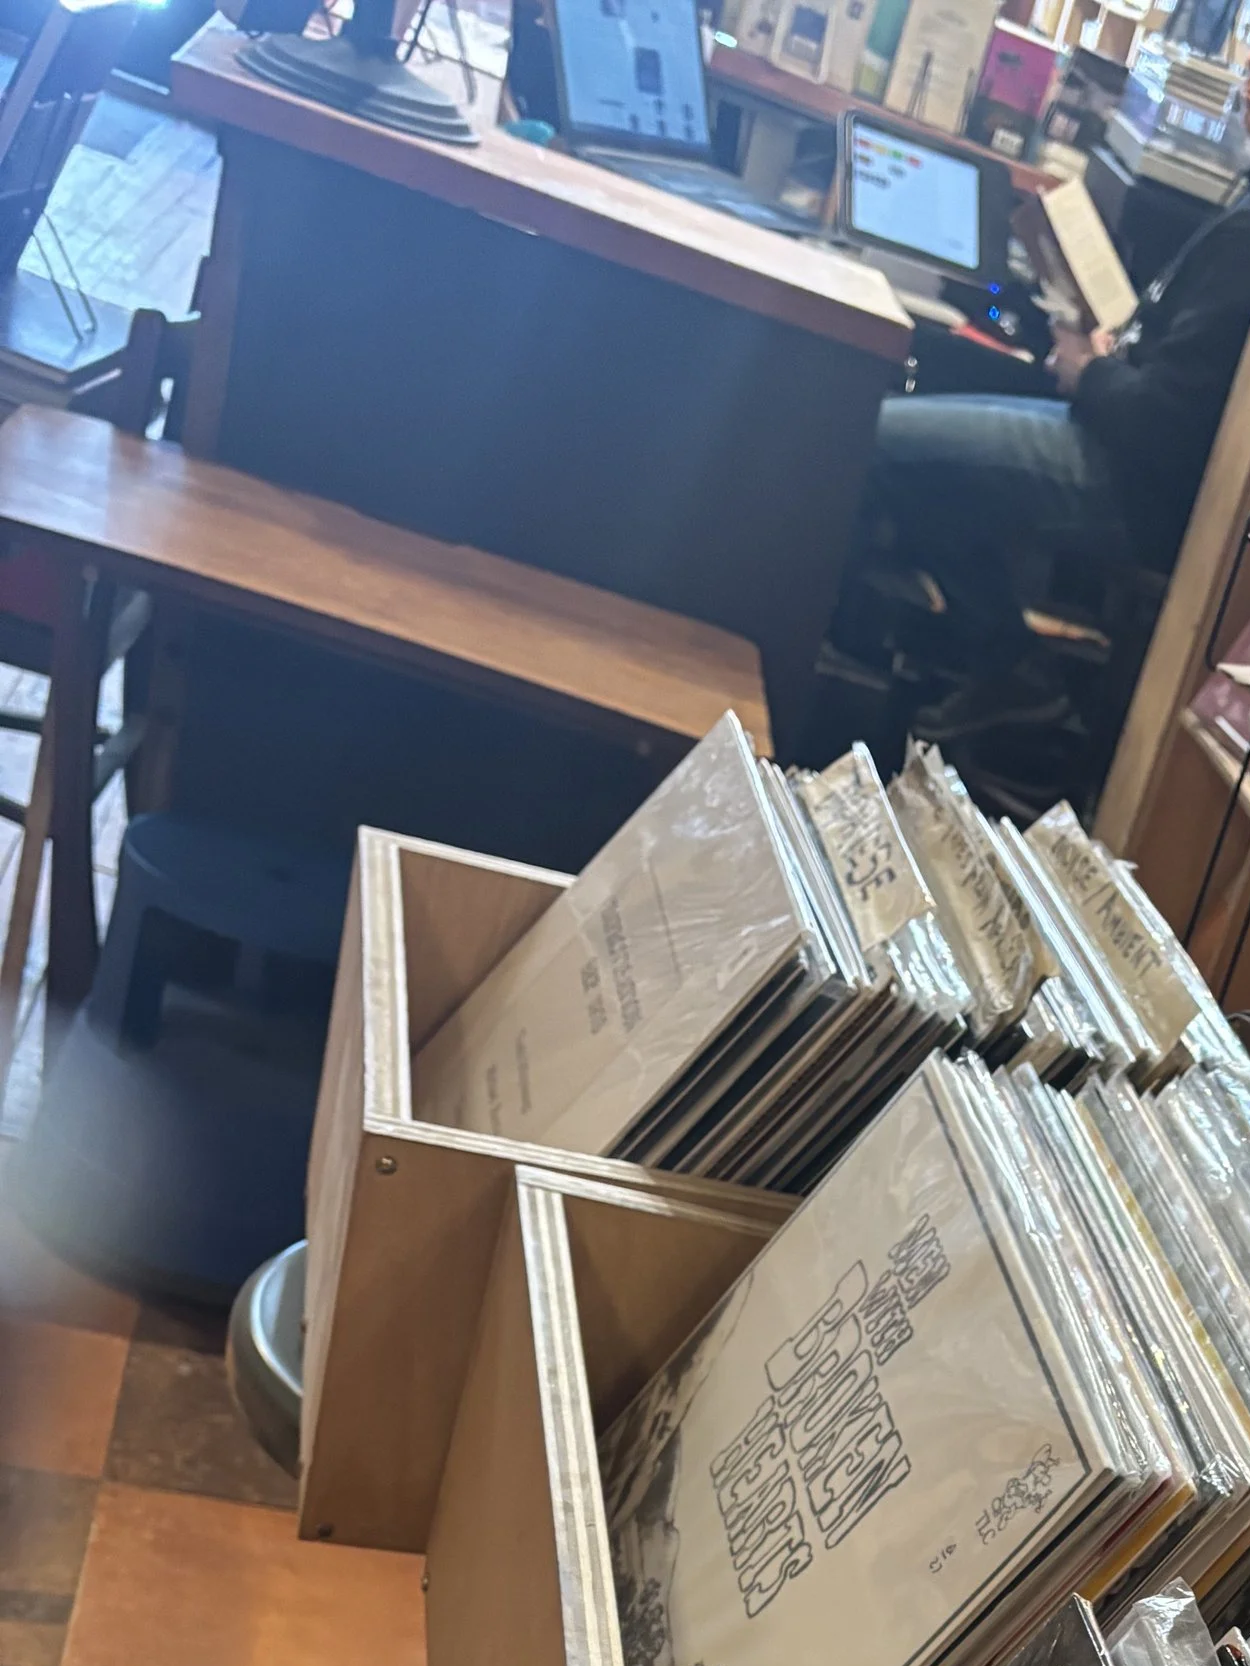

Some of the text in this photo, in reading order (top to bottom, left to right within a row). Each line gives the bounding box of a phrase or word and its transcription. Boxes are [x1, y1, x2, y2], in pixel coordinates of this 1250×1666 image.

[859, 1269, 914, 1366] WITH
[888, 1213, 951, 1309] MEN
[764, 1259, 911, 1550] BROKEN
[709, 1395, 813, 1619] HEARTS
